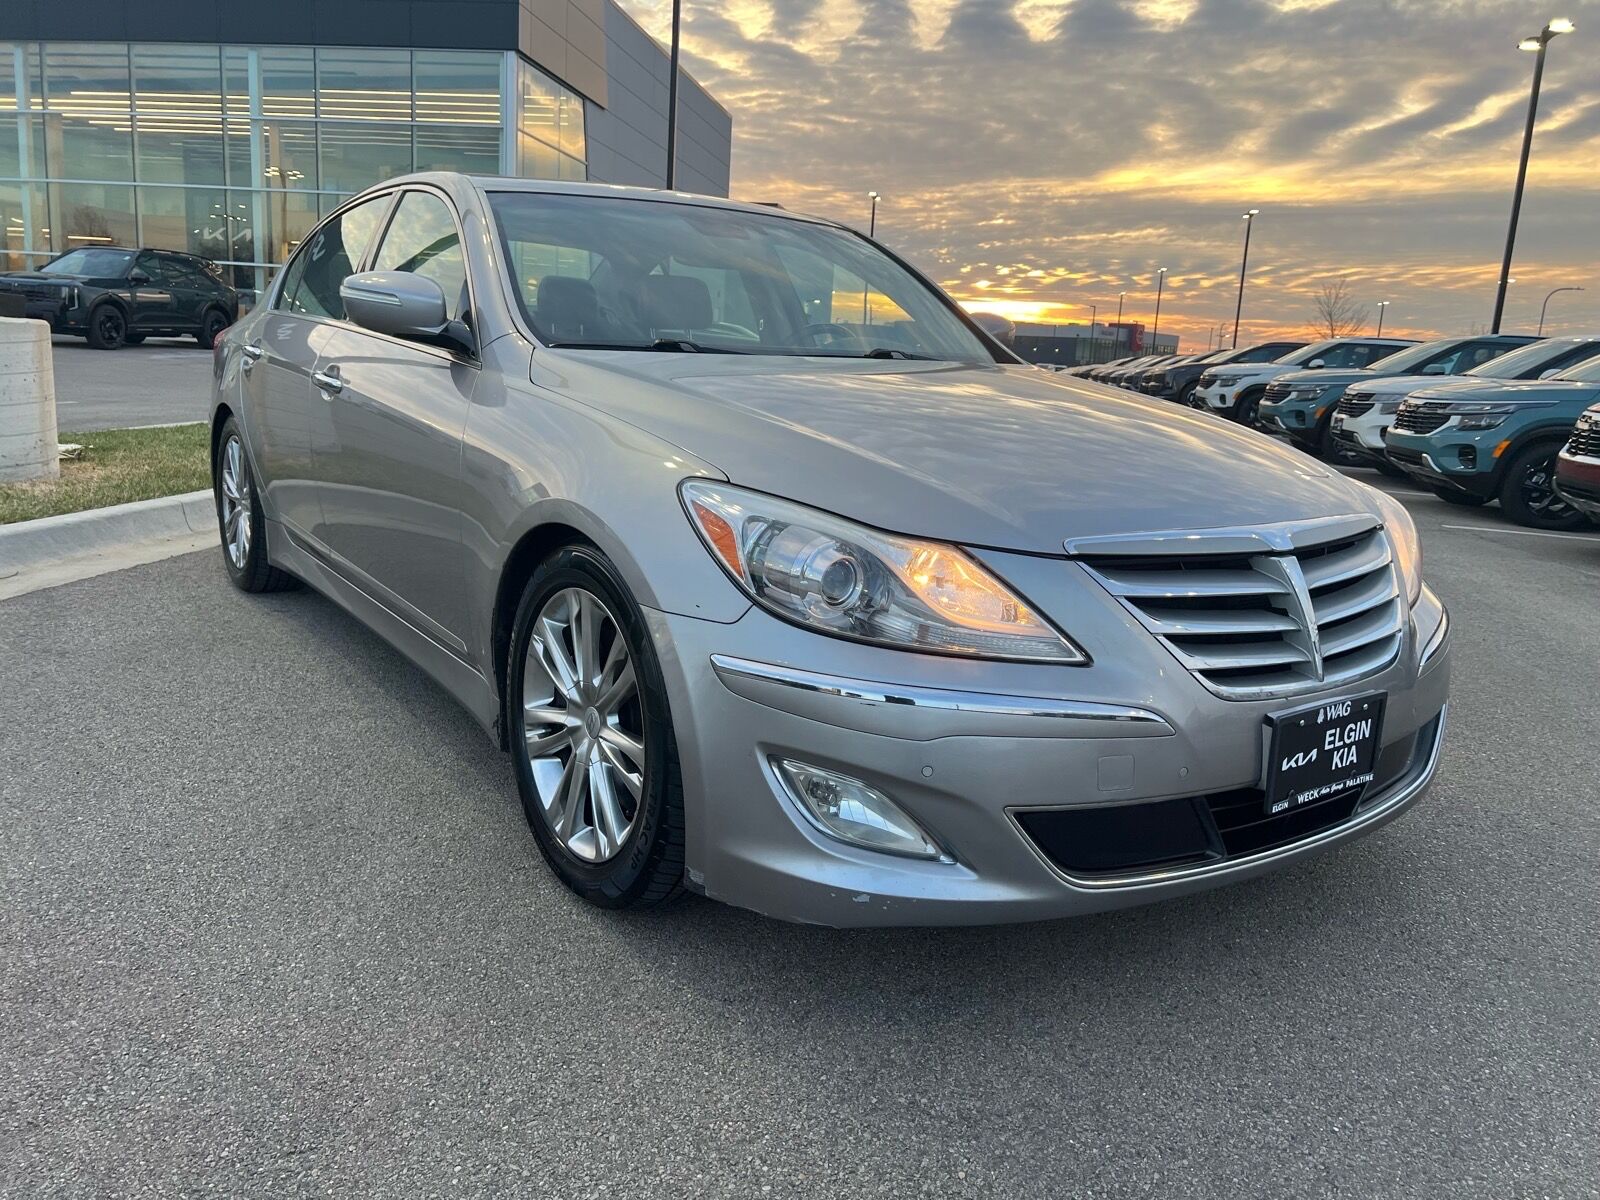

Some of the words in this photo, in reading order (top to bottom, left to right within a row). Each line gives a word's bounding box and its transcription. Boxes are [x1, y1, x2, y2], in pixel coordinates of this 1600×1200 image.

[1326, 701, 1352, 721] WAG
[1324, 719, 1371, 750] ELGIN
[1331, 745, 1358, 770] KIA
[1272, 801, 1289, 814] ELGIN
[1297, 789, 1320, 805] WECK
[1345, 774, 1374, 787] PALATINE
